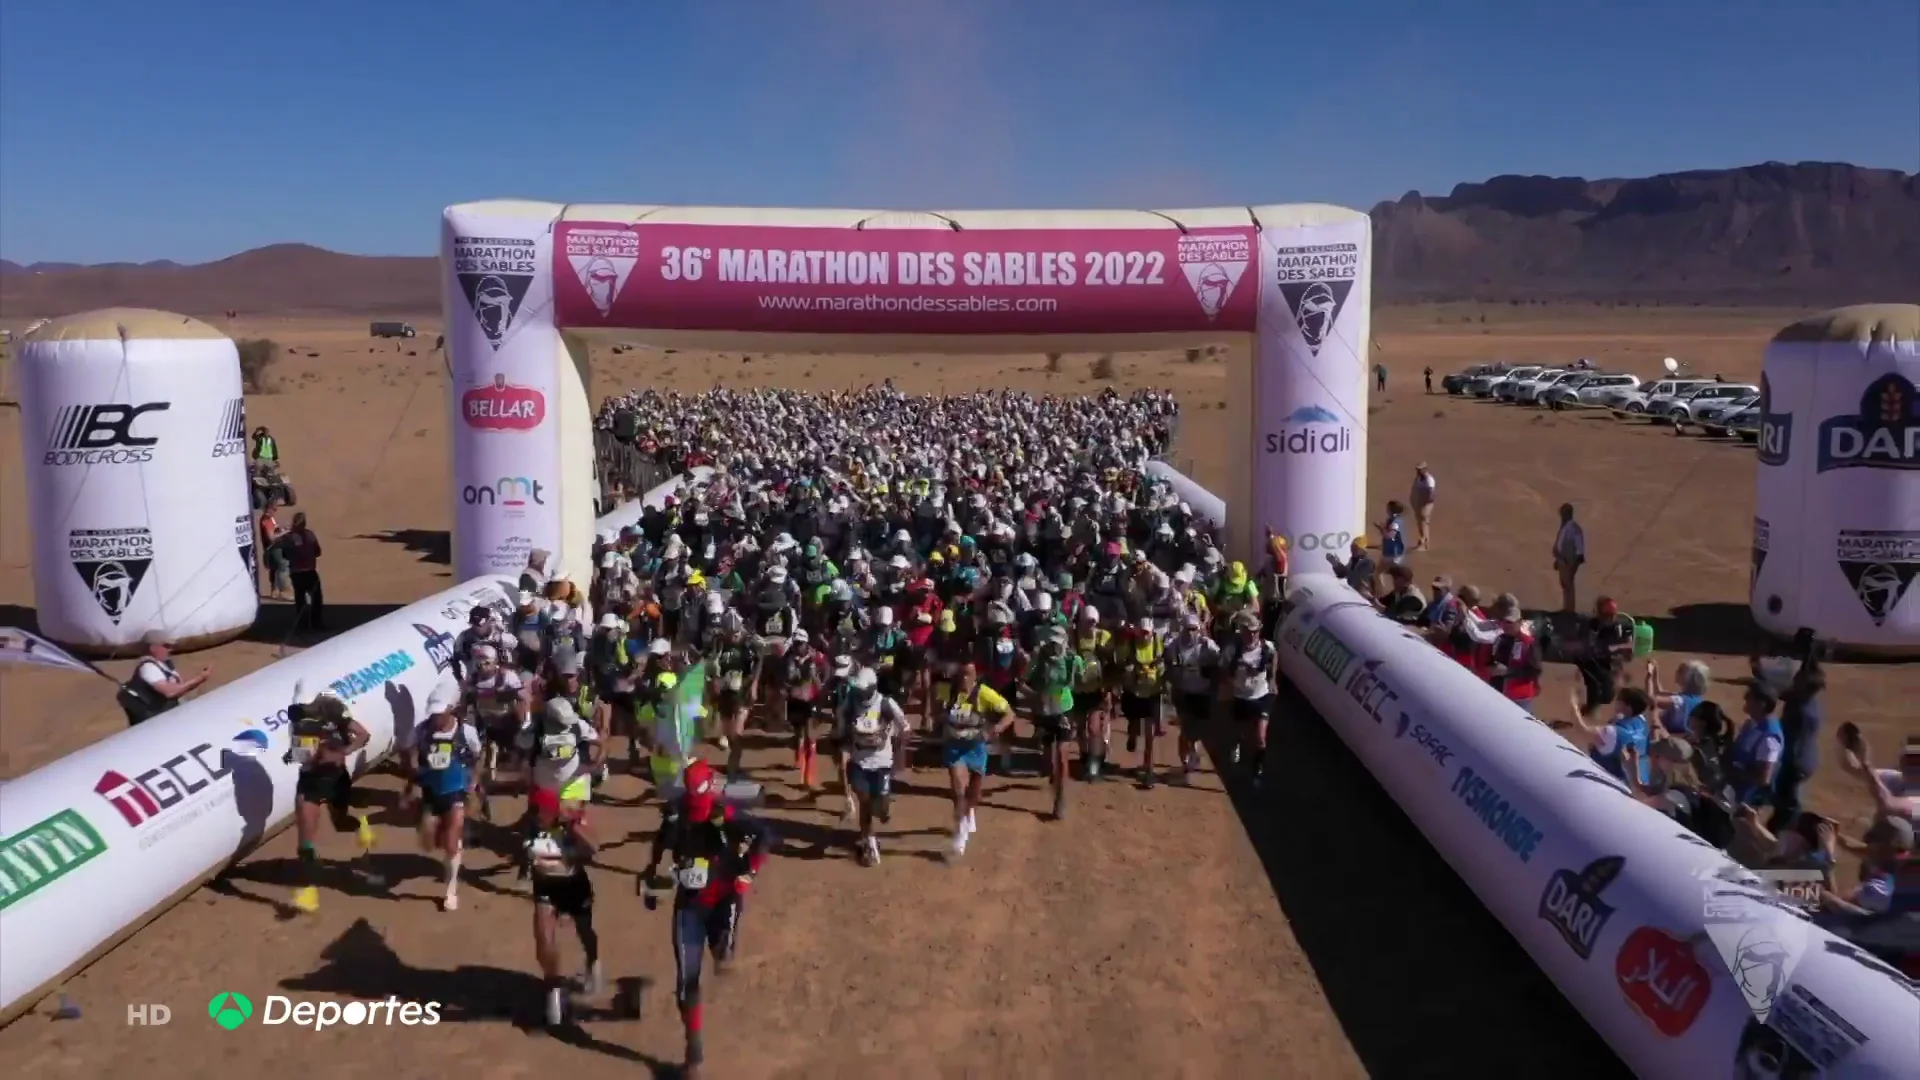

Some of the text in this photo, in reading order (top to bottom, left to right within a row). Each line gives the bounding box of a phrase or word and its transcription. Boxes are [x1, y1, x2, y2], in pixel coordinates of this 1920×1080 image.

[567, 235, 639, 246] MARATHON
[1178, 241, 1249, 252] MARATHON
[454, 247, 535, 260] MARATHON
[1277, 254, 1357, 268] MARATHON
[481, 261, 535, 273] SABLES
[718, 248, 889, 285] MARATHON
[898, 251, 955, 286] DES
[963, 251, 1077, 286] SABLES
[1085, 251, 1165, 286] 2022
[1278, 266, 1356, 281] DES SABLES
[758, 294, 1057, 312] www.marathondessables.com
[469, 400, 536, 418] BELLAR
[1266, 427, 1350, 454] sidi ali
[44, 448, 154, 466] BODYCROSS
[69, 536, 152, 549] MARATHON
[1547, 877, 1602, 945] DARI
